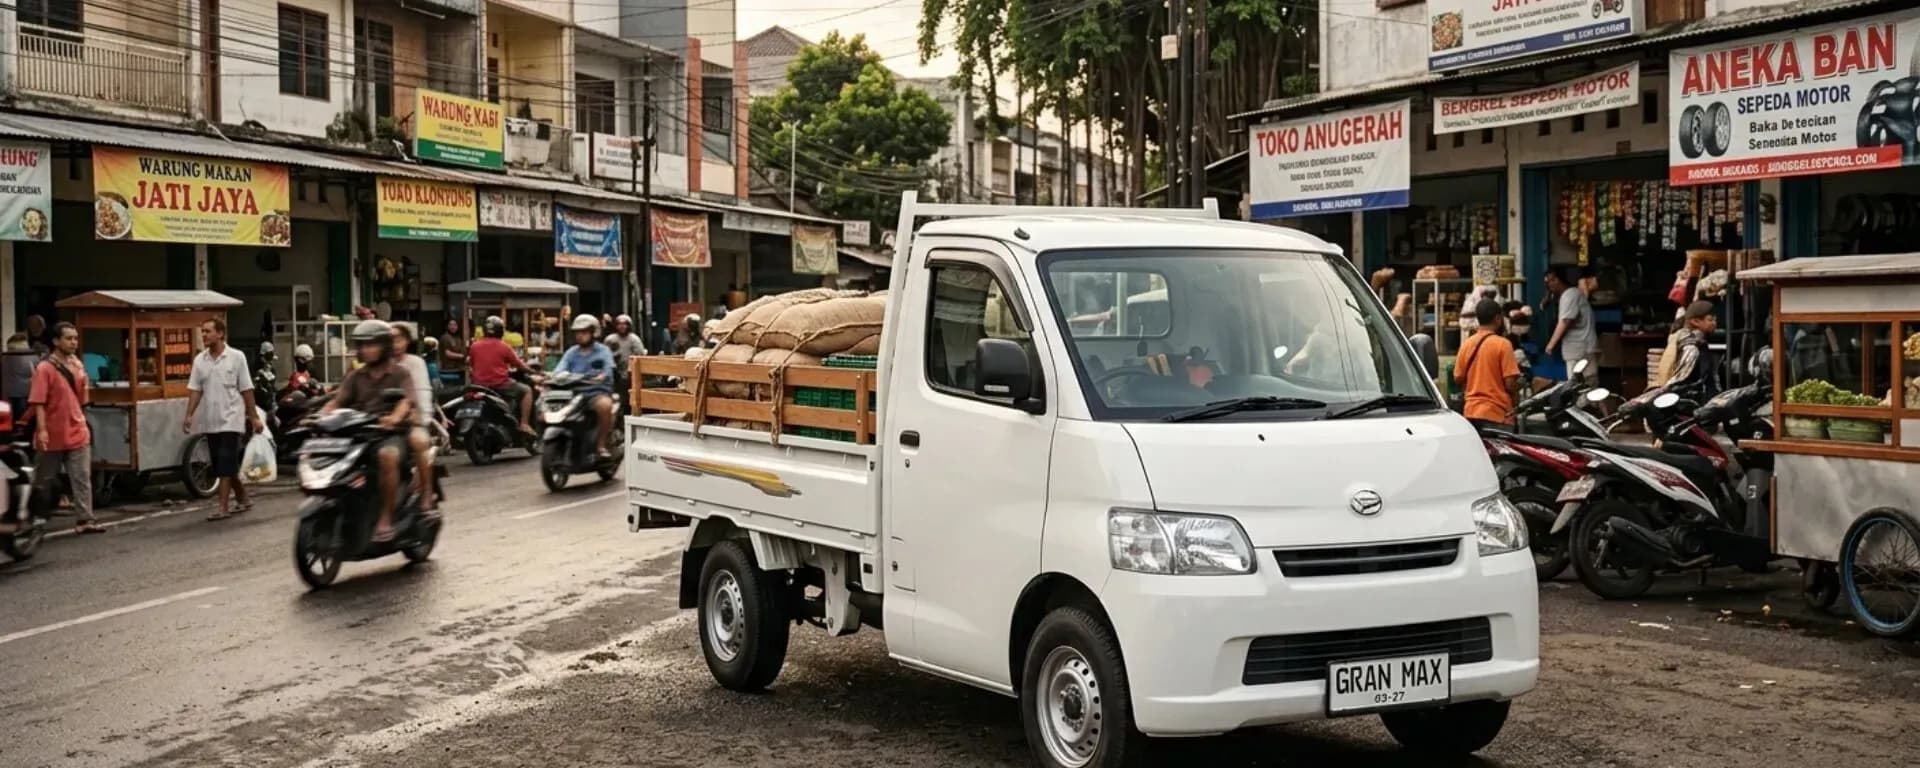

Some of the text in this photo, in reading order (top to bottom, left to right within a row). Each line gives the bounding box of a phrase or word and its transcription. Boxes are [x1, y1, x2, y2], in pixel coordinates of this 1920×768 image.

[1681, 23, 1895, 97] ANEKA BAN
[1737, 84, 1851, 114] SEPEDA MOTOR
[1256, 110, 1403, 157] TOKO ANUGERAH
[1750, 121, 1778, 133] Baka
[138, 157, 201, 178] WARUNG
[132, 181, 260, 215] JATI JAYA
[1336, 658, 1442, 694] GRAN MAX
[1374, 691, 1406, 703] 03-27
